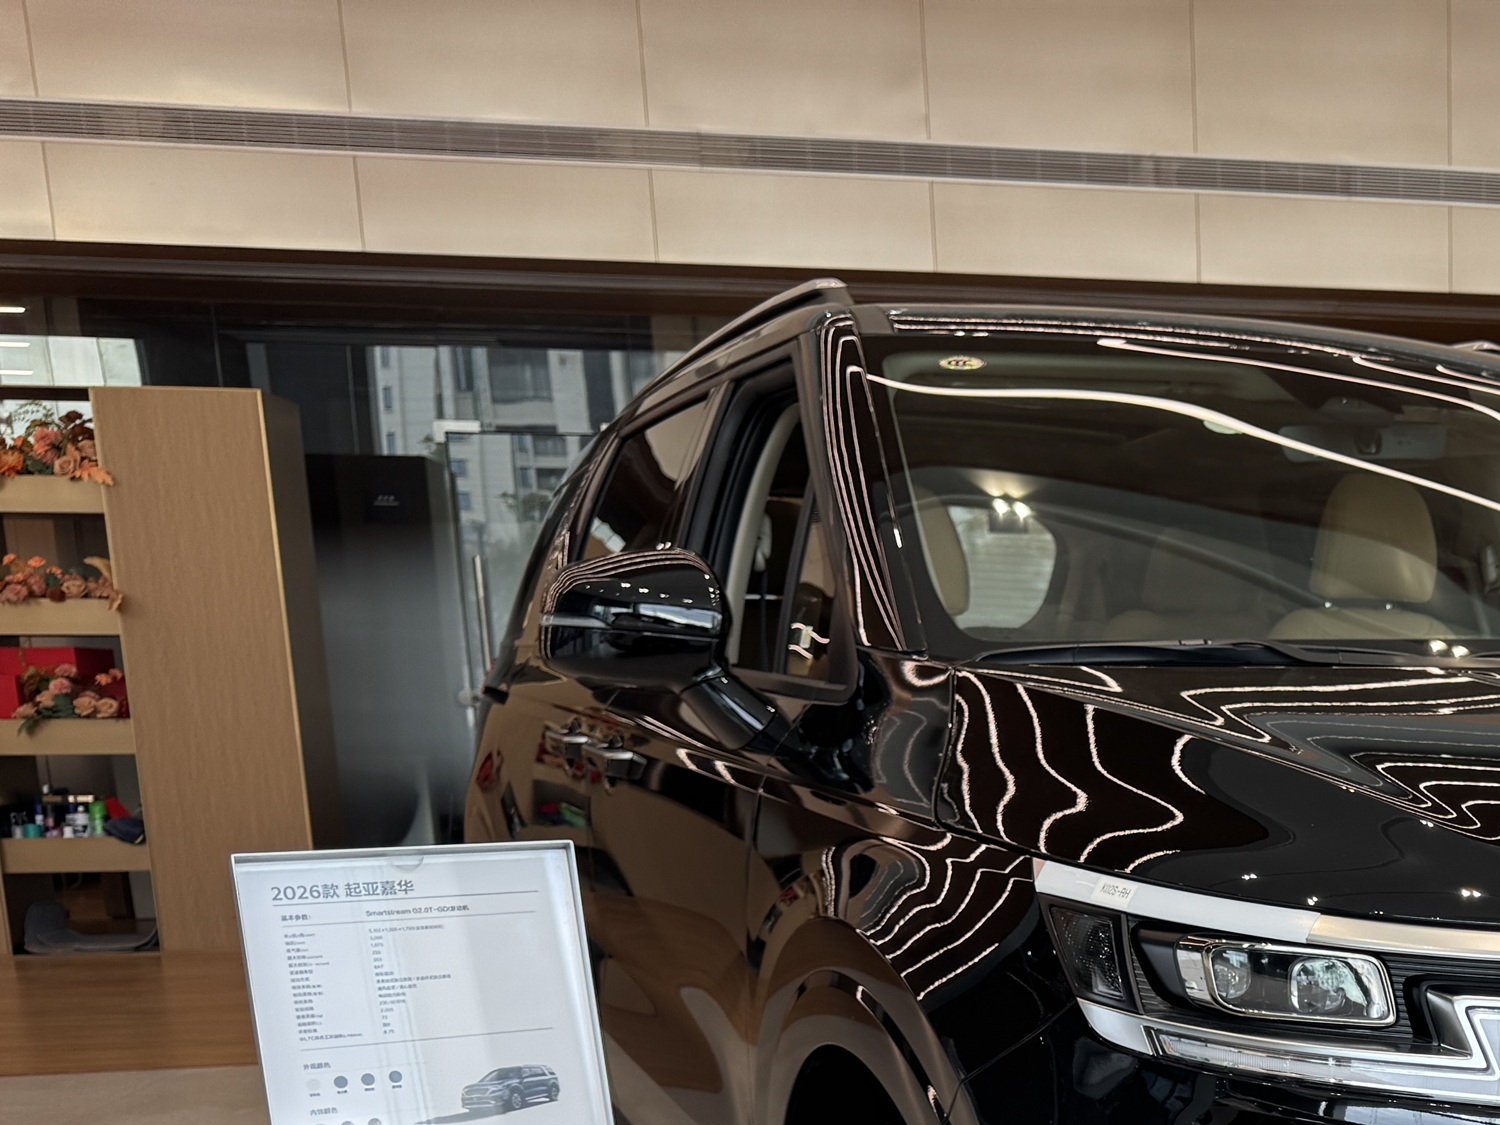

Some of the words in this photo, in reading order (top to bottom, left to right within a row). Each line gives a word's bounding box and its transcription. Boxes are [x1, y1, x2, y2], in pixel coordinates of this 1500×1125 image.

[271, 883, 340, 901] 2026款
[344, 879, 414, 898] 起亚嘉华
[366, 908, 411, 917] Smartstream
